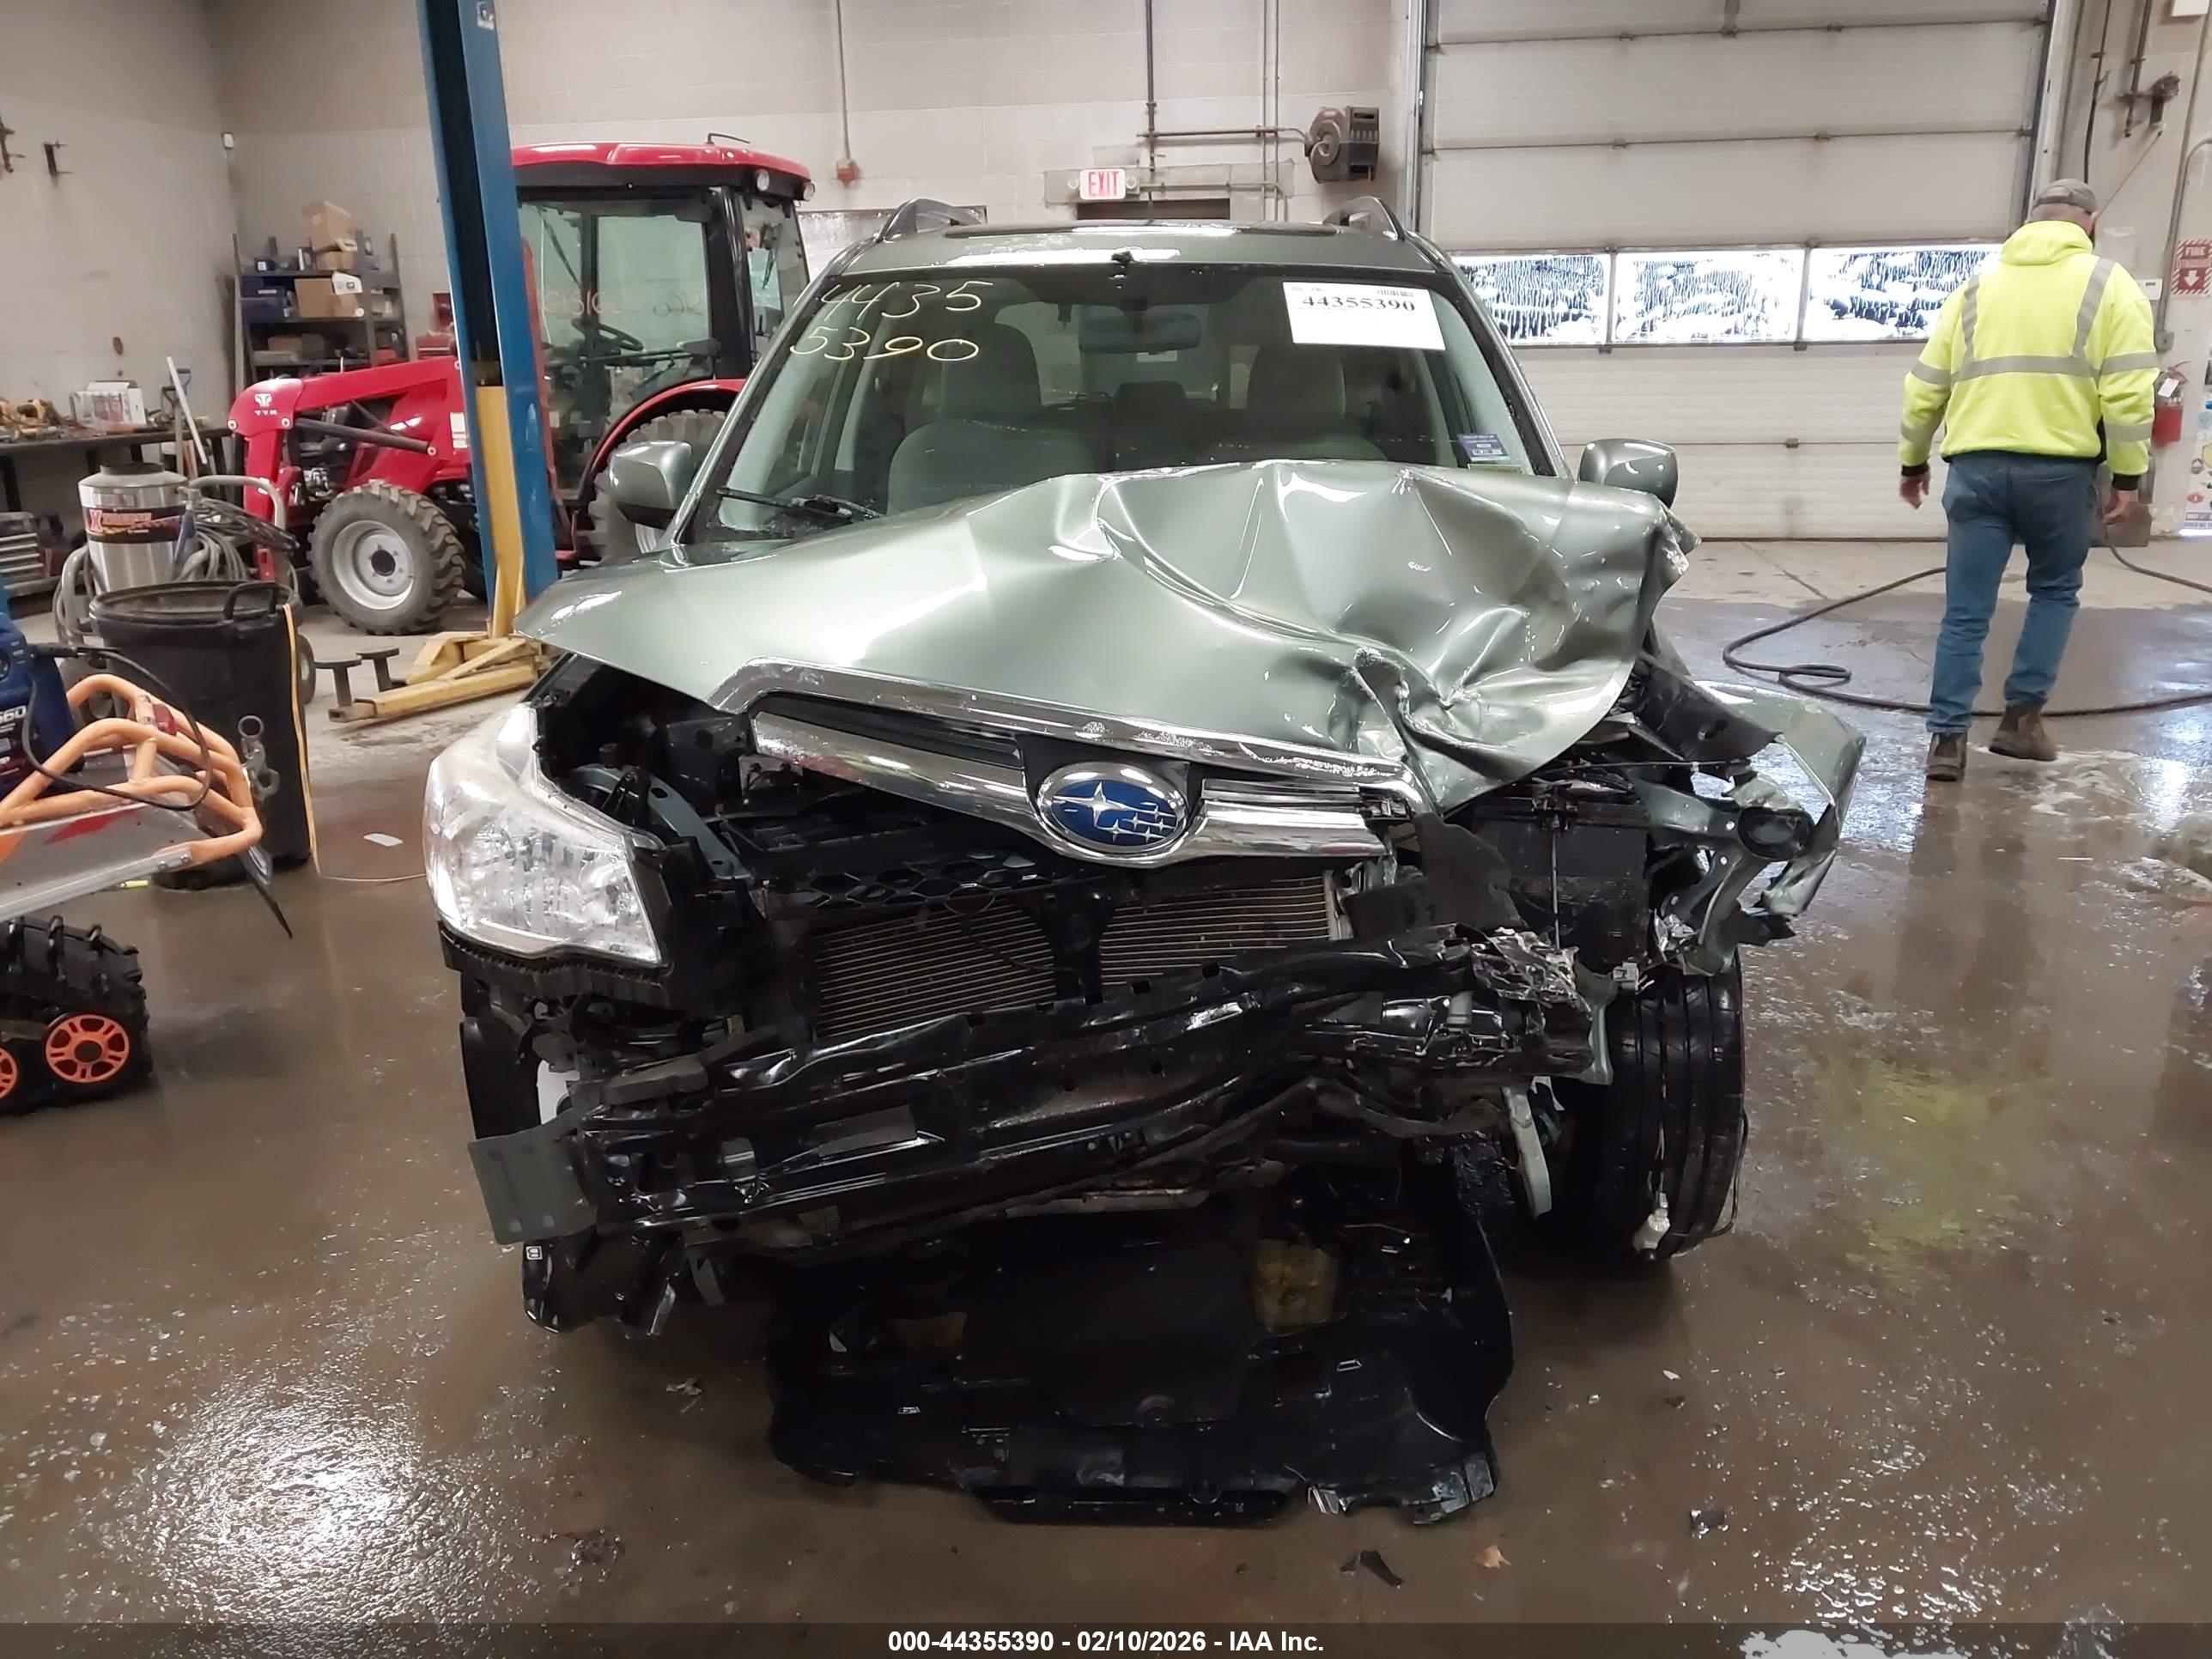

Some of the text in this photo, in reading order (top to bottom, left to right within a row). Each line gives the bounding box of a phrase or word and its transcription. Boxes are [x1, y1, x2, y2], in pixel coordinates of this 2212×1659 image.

[1088, 171, 1119, 196] EXIT
[2185, 246, 2206, 256] FIRE
[821, 281, 994, 321] 4435
[1303, 295, 1415, 312] 44355390
[790, 325, 979, 361] 5390
